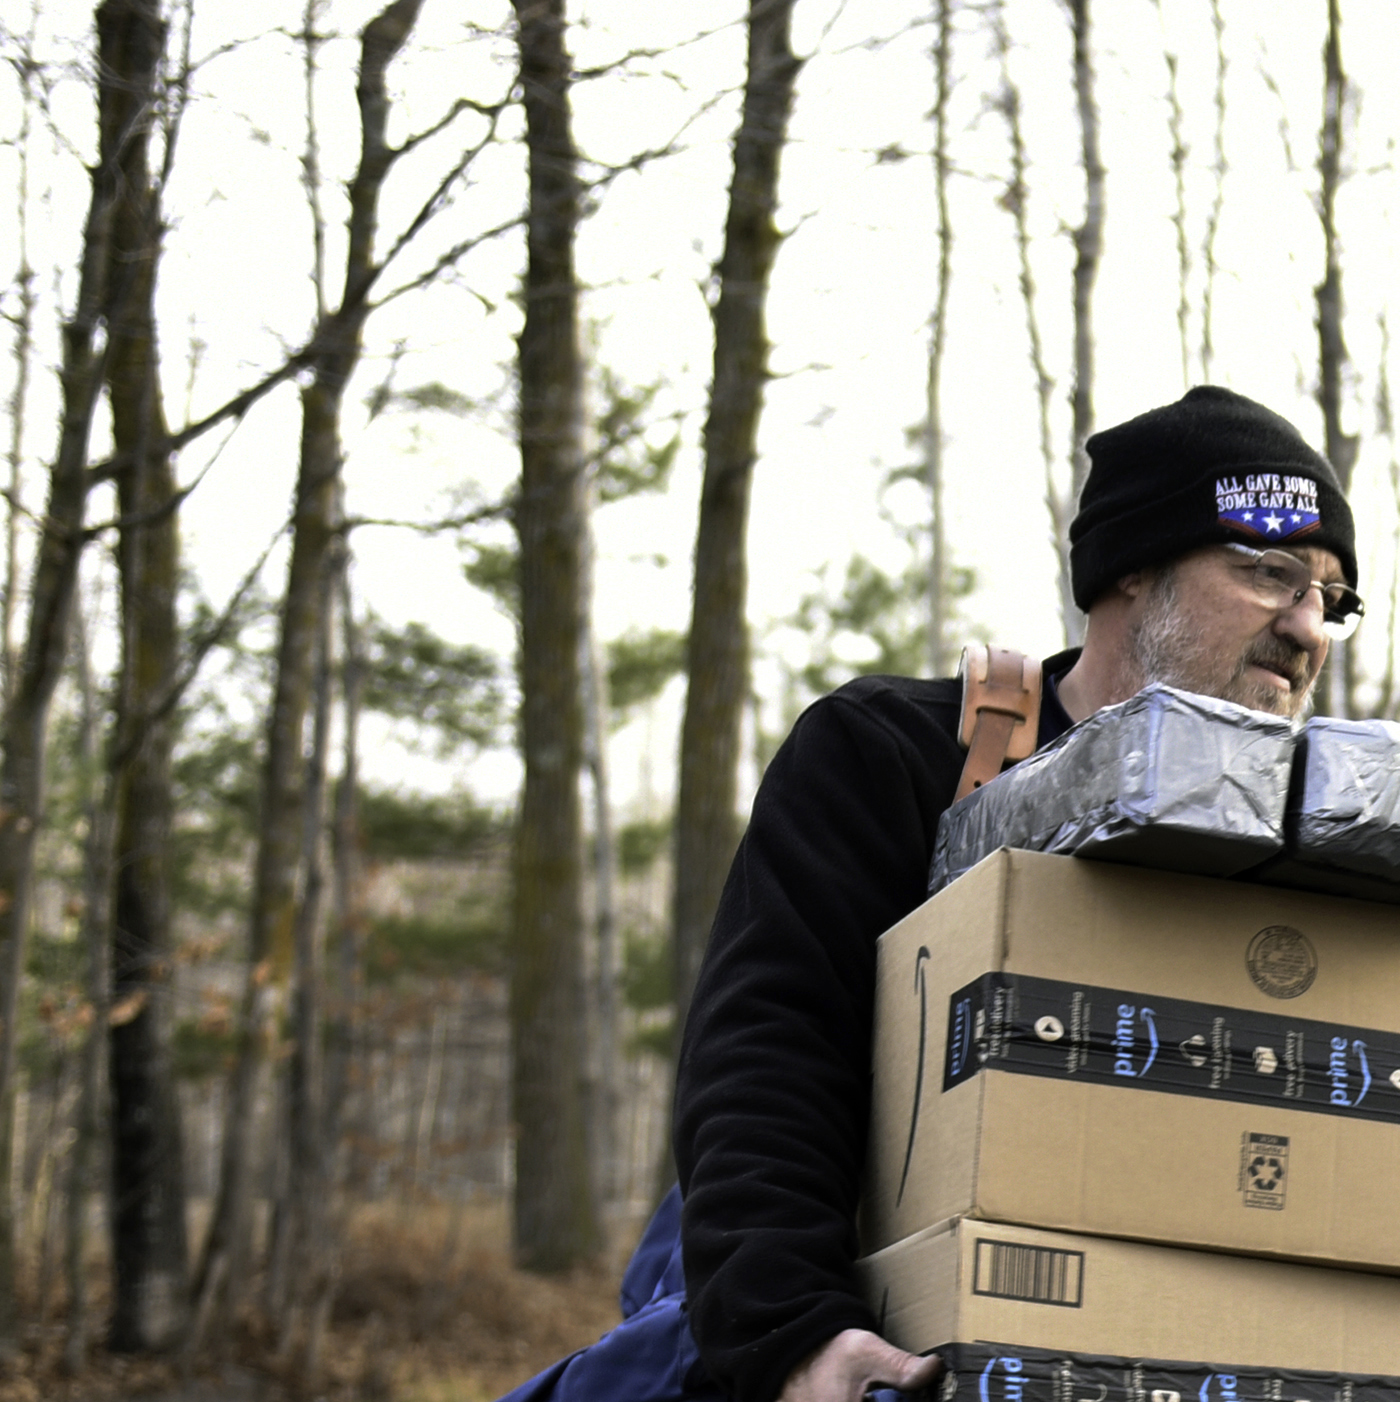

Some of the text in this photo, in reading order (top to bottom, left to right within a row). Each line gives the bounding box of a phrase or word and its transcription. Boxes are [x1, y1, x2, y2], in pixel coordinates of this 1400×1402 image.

[1216, 473, 1318, 496] ALL GAVE SOME
[1217, 491, 1320, 514] SOME GAVE ALL
[1110, 1003, 1138, 1077] prime
[1326, 1036, 1352, 1106] prime
